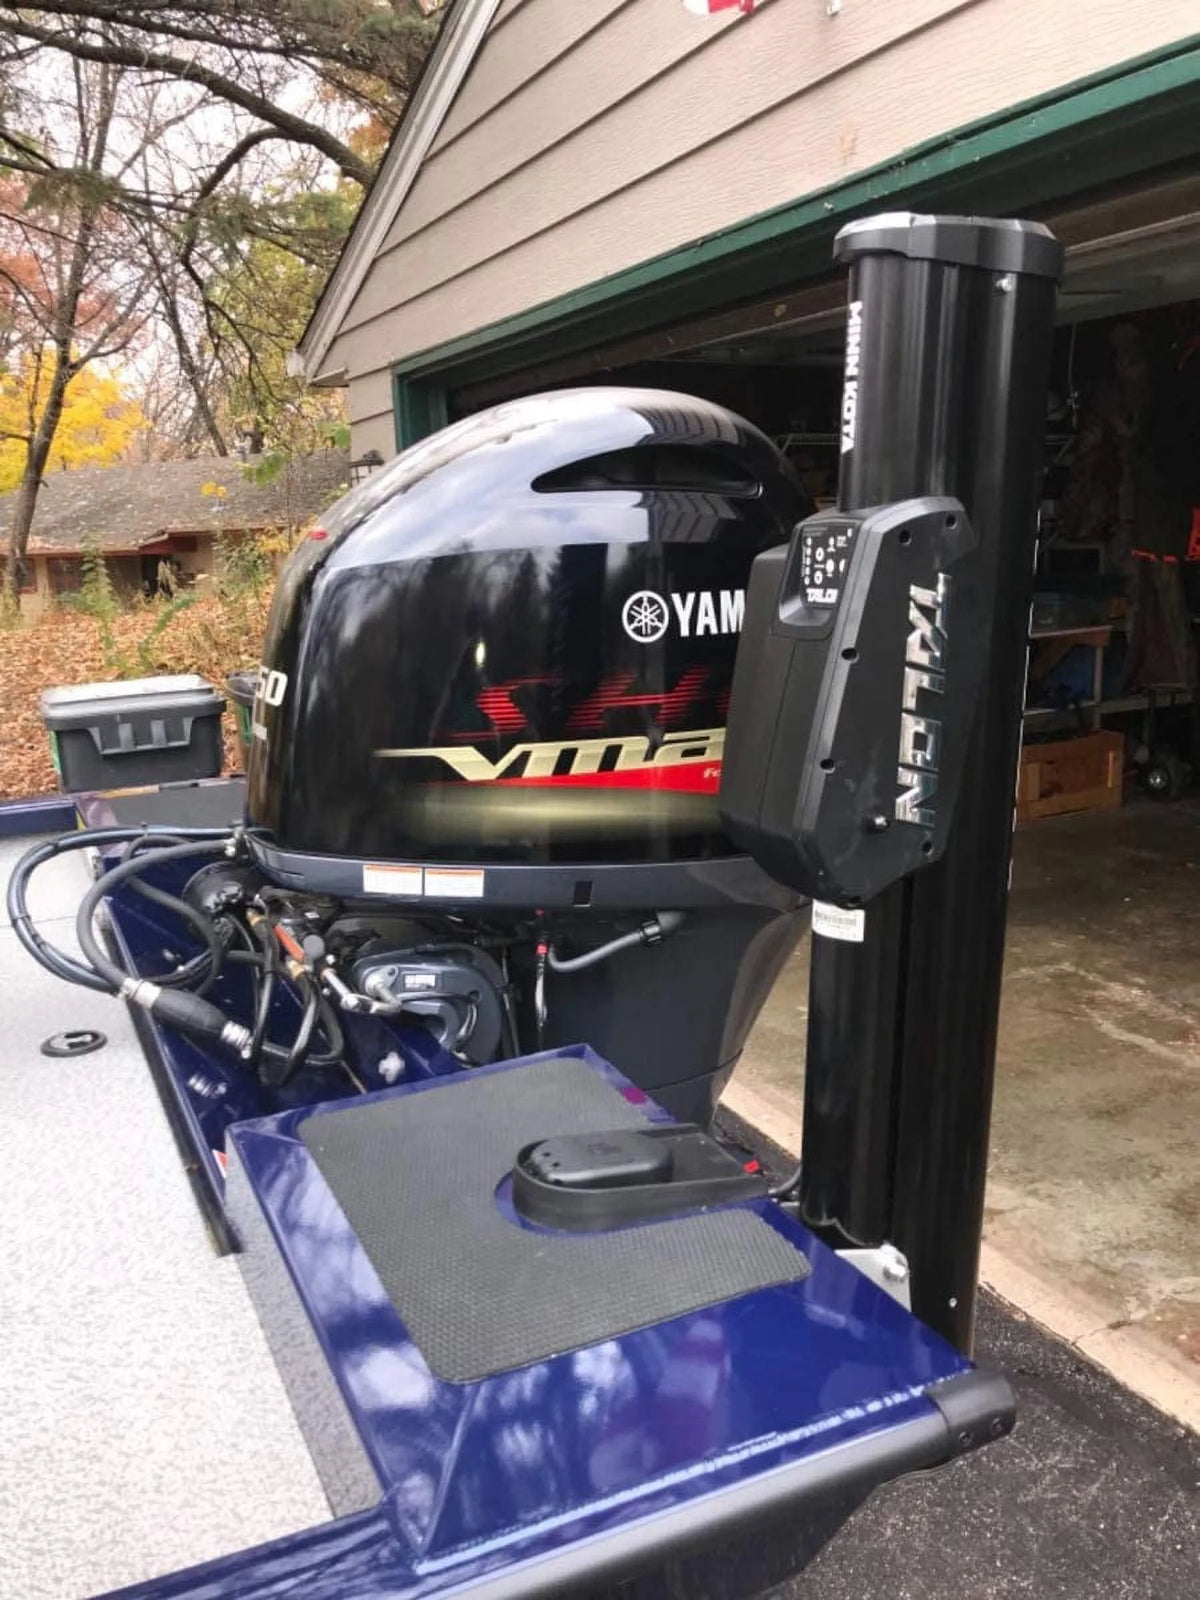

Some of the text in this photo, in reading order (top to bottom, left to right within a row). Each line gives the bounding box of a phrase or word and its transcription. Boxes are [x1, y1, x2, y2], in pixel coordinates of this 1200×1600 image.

[841, 301, 863, 454] MINN KOTA
[671, 589, 746, 637] YAM
[255, 666, 288, 707] 50
[434, 662, 731, 742] SH
[895, 572, 952, 828] TALON
